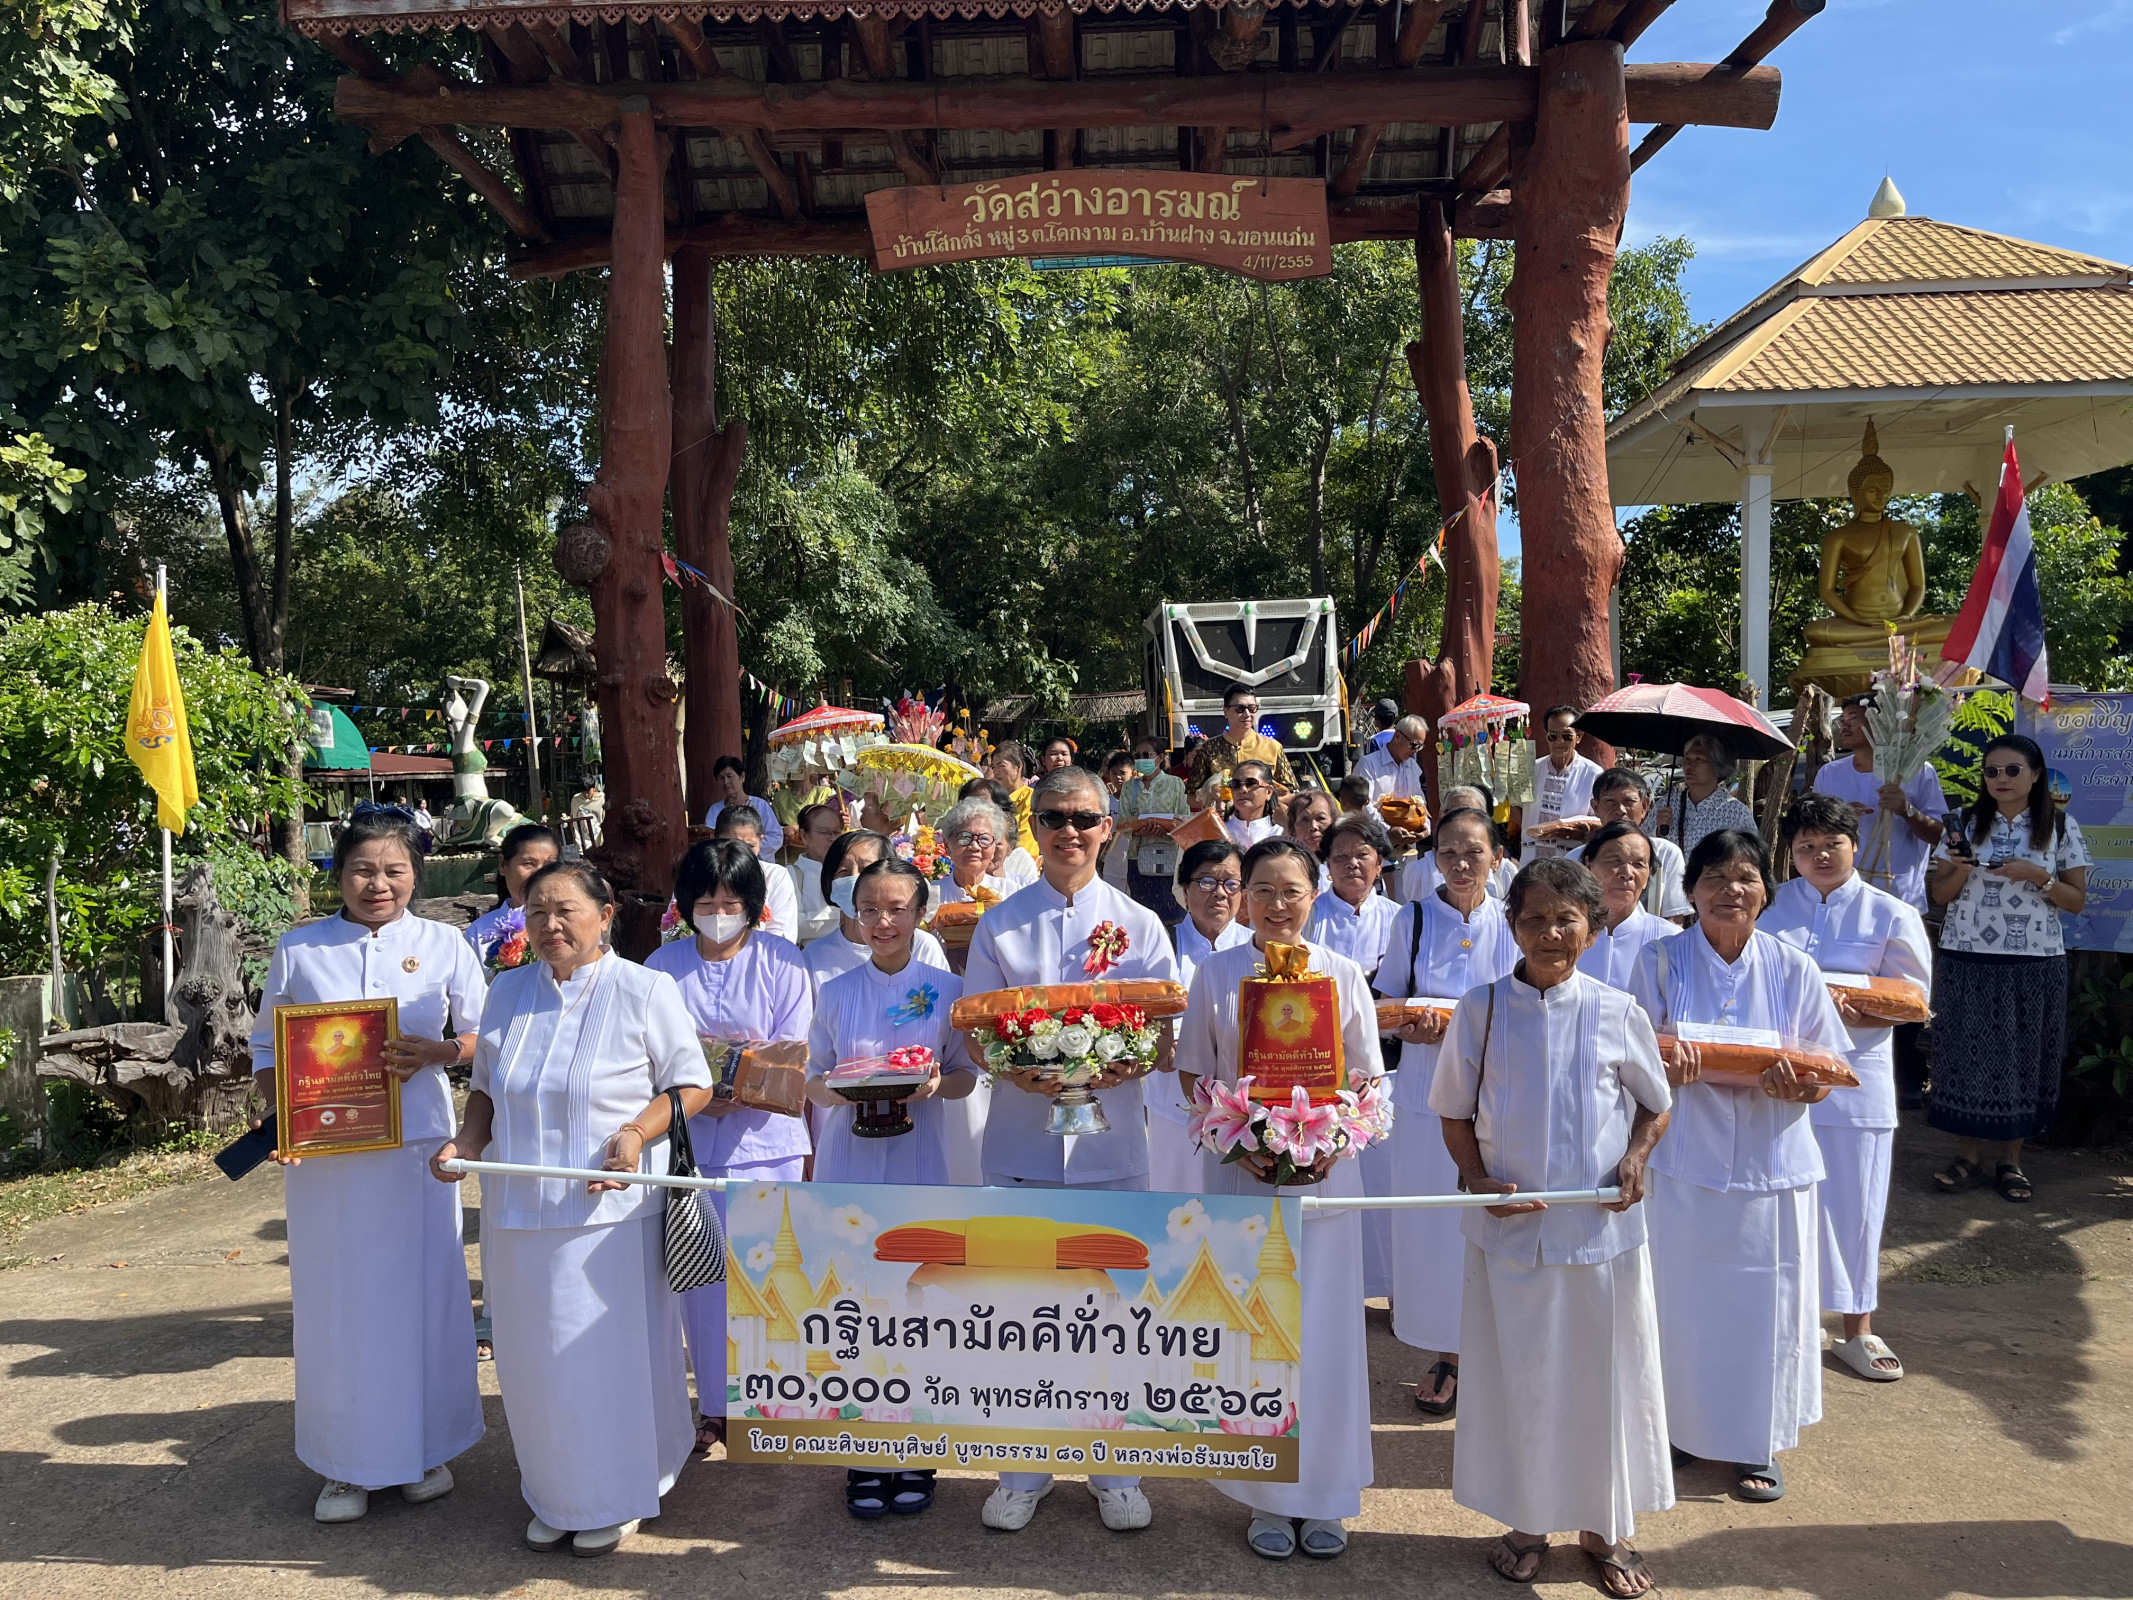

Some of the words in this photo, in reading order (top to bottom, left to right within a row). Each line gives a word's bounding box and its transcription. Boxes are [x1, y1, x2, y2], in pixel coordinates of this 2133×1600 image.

[963, 179, 1258, 223] วัดสว่างอารมณ์
[1121, 220, 1214, 243] อ.บ้านฝาง
[1219, 226, 1316, 247] จ.ขอนแก่น
[1242, 254, 1314, 271] 4/11/2555
[2057, 698, 2132, 735] ขอเชิญ
[1248, 1047, 1331, 1062] กฐินสามัคคีทั่วไทย
[298, 1069, 382, 1088] กฐินสามัคคีทั่วไทย
[802, 1294, 1222, 1359] กฐินสามัคคีทั่วไทย
[745, 1373, 911, 1408] ๓๐,๐๐๐
[923, 1375, 960, 1405] วัด
[969, 1379, 1130, 1418] พุทธศักราช
[1144, 1381, 1283, 1418] ๒๕๖๘
[749, 1430, 787, 1451] โดย
[795, 1434, 947, 1462] คณะศิษยานุศิษย์
[955, 1441, 1048, 1463] บูชาธรรม
[1056, 1448, 1085, 1463] ๘๑
[1092, 1440, 1107, 1462] ปี
[1114, 1444, 1277, 1469] หลวงพ่อธัมมชโย
